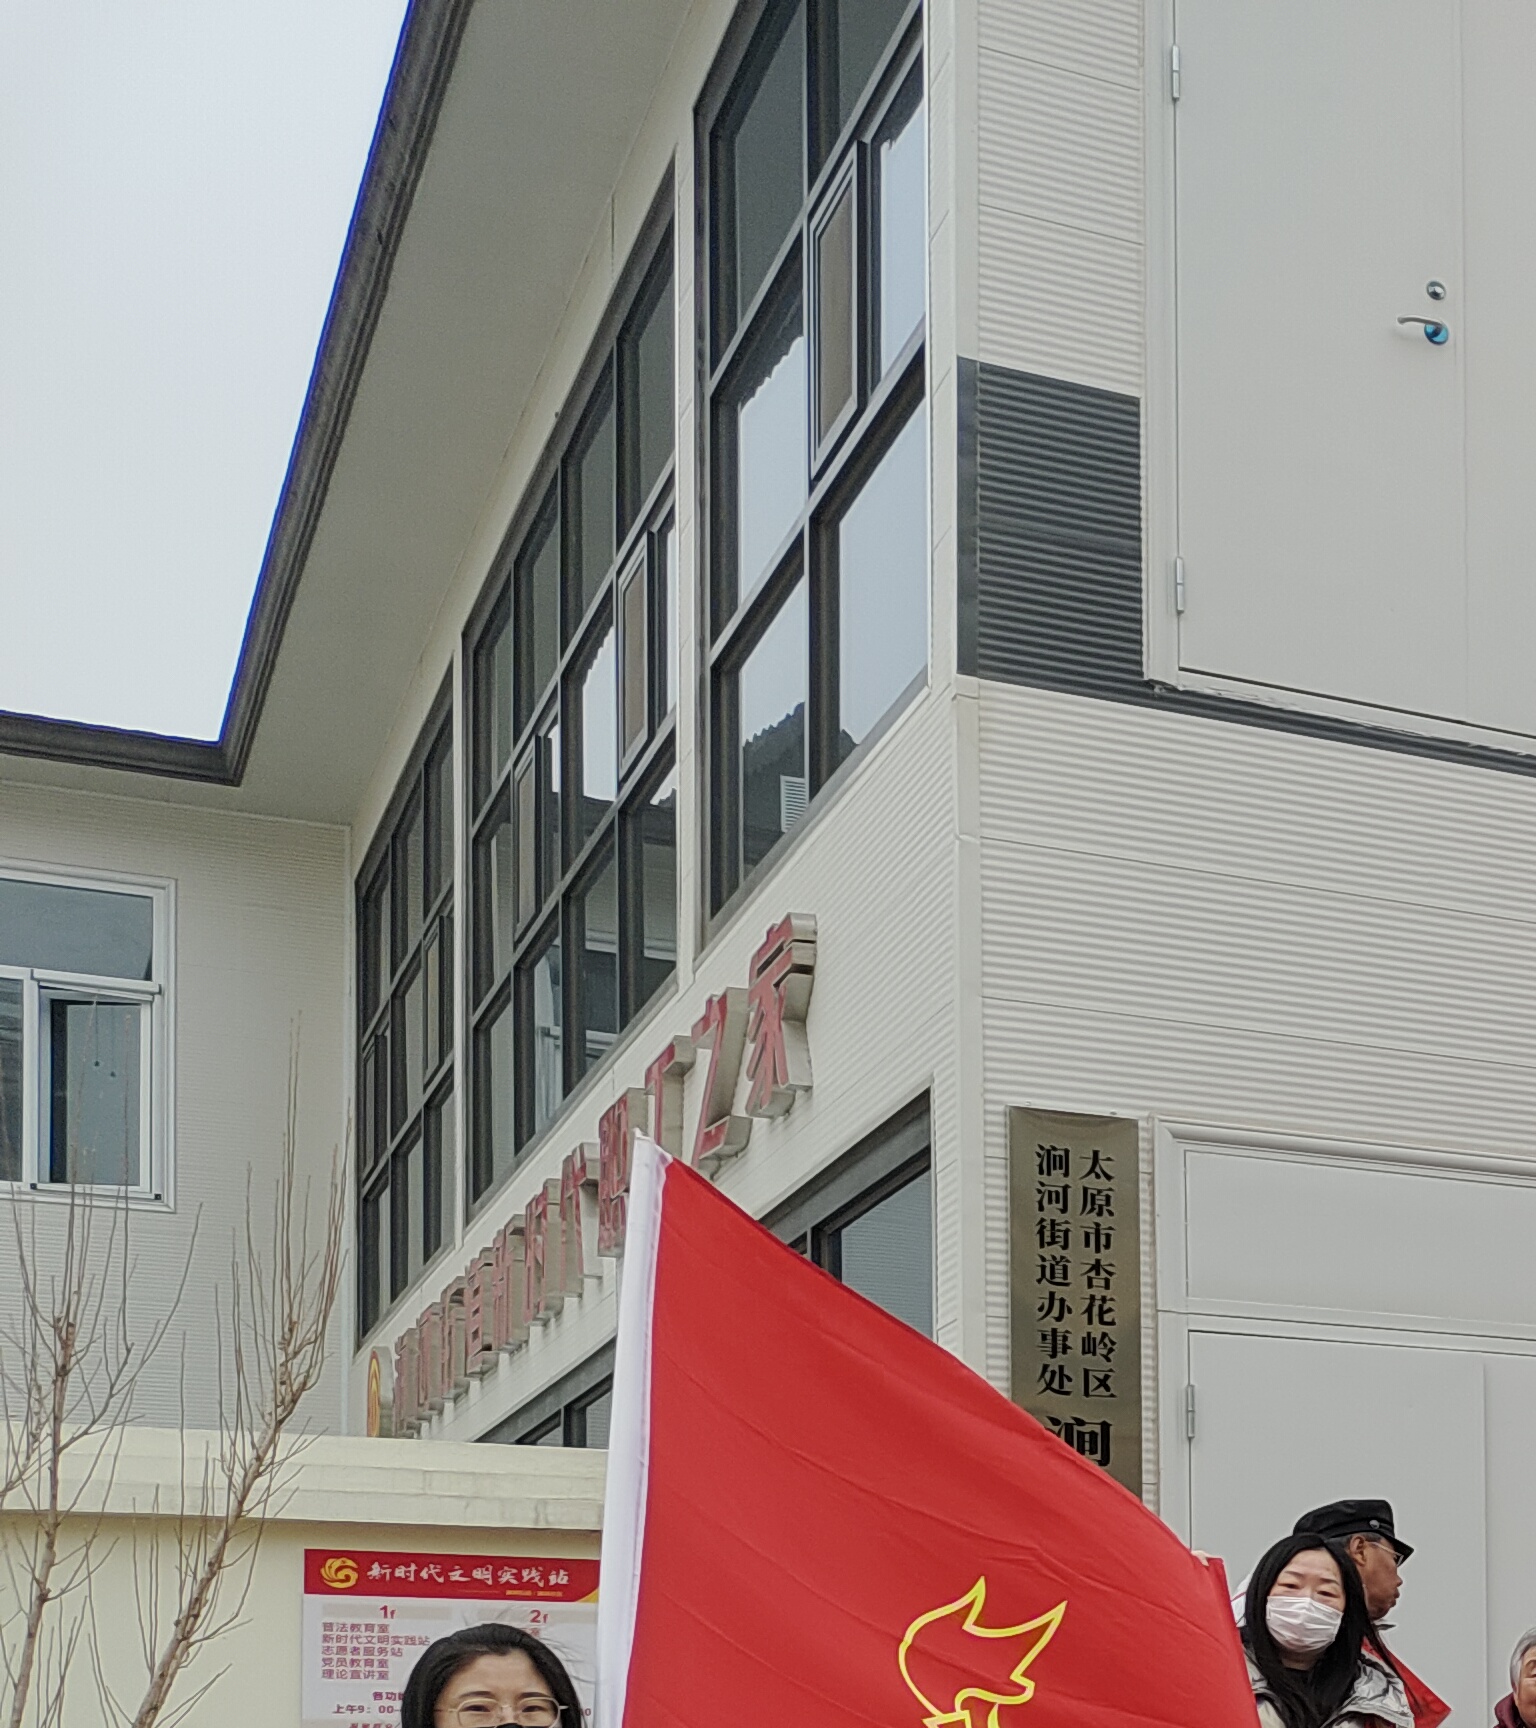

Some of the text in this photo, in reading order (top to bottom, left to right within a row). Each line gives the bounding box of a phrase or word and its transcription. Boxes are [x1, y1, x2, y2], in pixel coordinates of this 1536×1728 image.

[1034, 1143, 1074, 1397] 涧河街道办事处
[1079, 1148, 1117, 1399] 太原市杏花岭区
[367, 1561, 569, 1588] 新时代文明实践站
[321, 1633, 430, 1646] 新时代文明实践站
[321, 1645, 403, 1657] 志愿者服务站
[321, 1657, 389, 1669] 党员教育室
